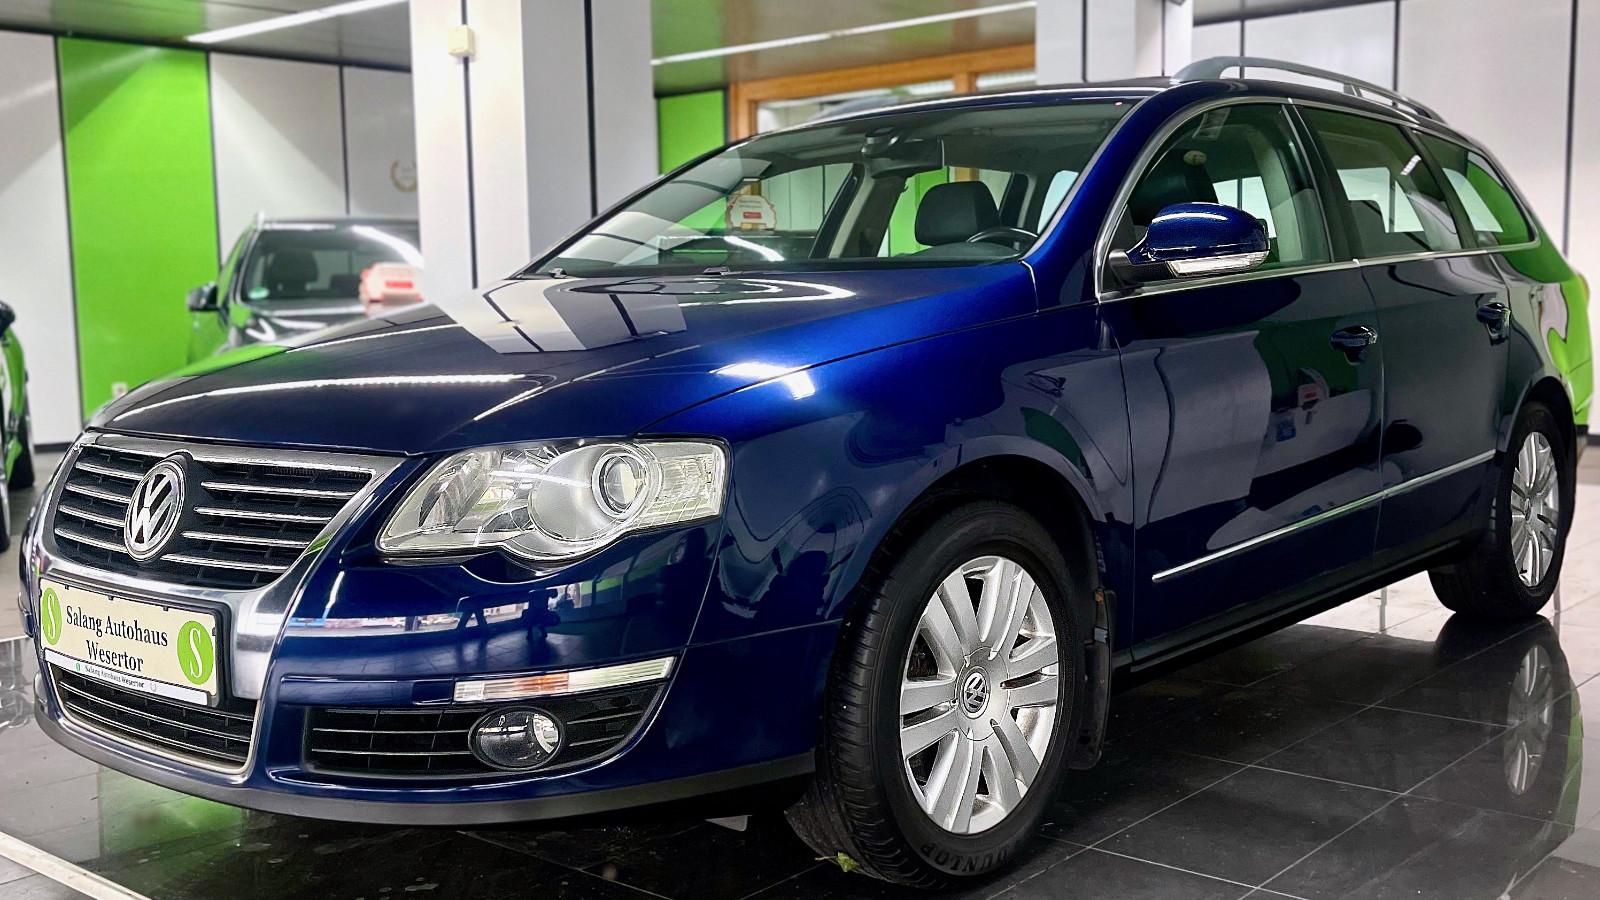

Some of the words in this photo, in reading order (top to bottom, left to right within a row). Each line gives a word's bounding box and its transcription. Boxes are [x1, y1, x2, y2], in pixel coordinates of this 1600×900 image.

[66, 605, 103, 637] Salang
[104, 616, 168, 647] Autohaus
[86, 639, 144, 672] Wesertor
[920, 842, 1008, 872] DUNLOP
